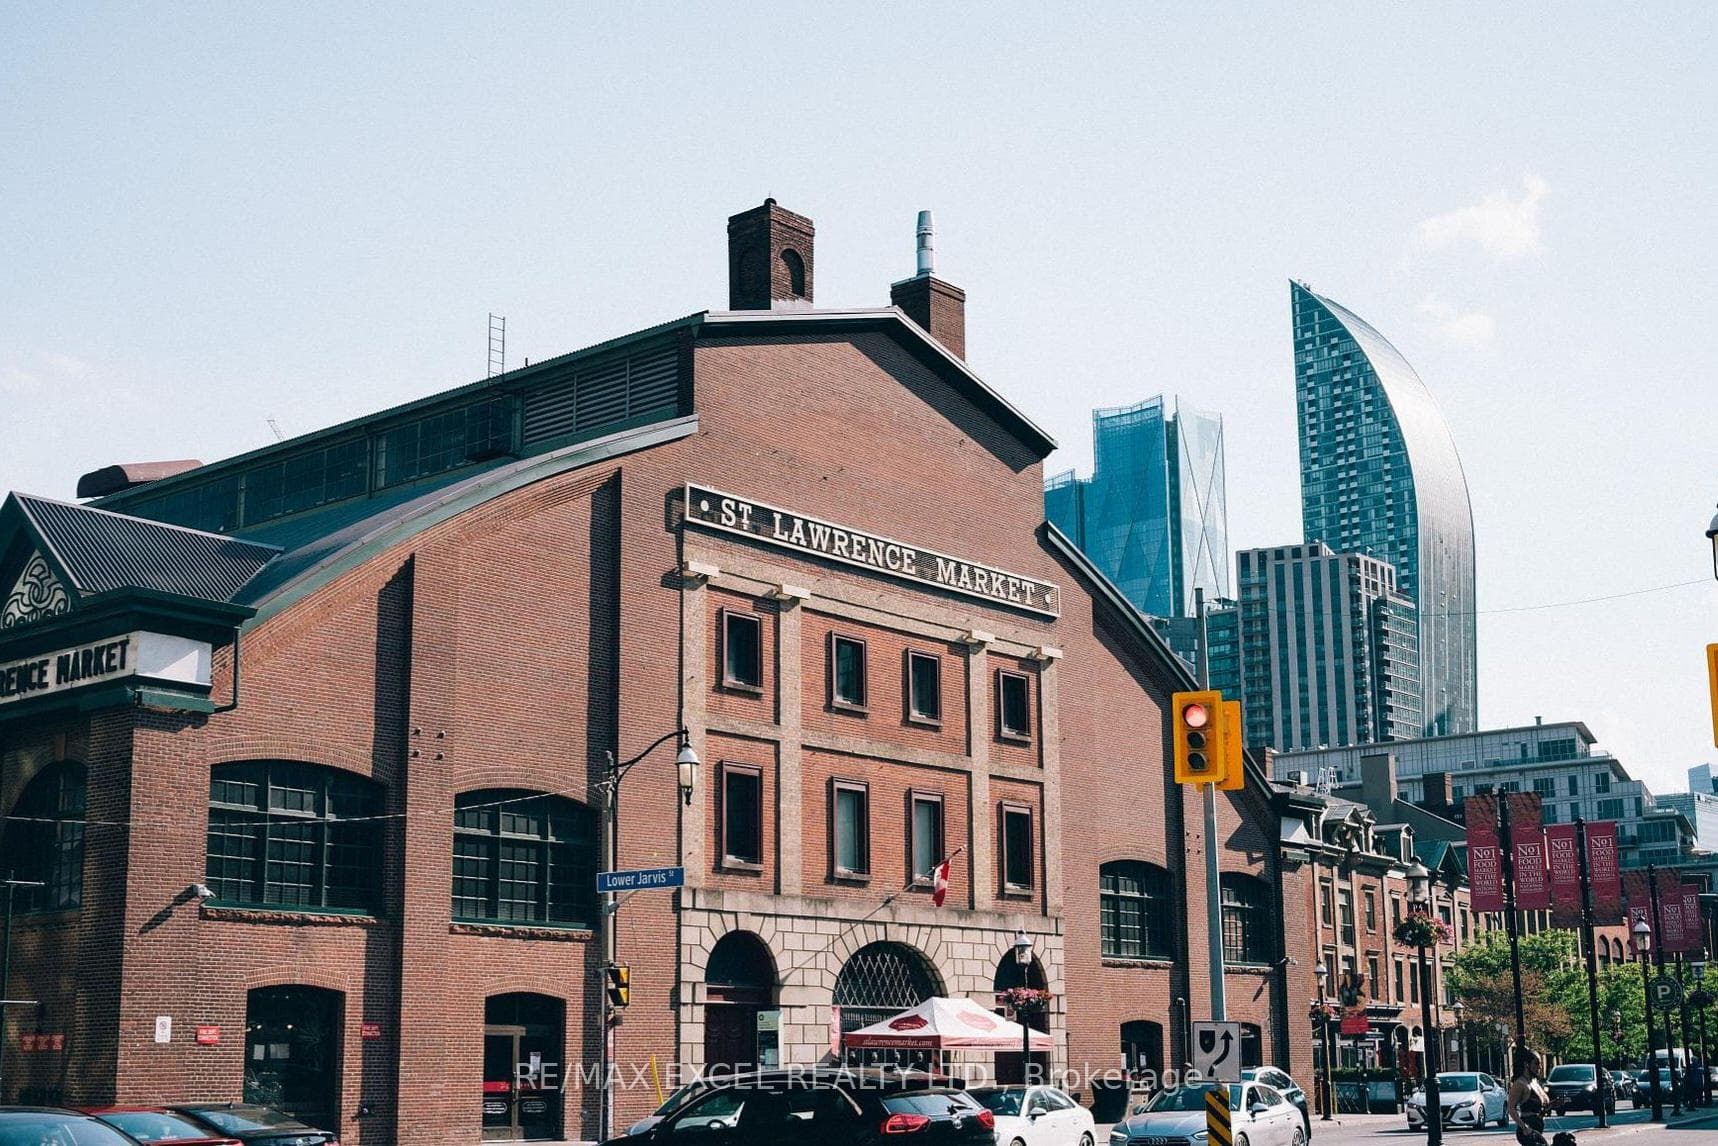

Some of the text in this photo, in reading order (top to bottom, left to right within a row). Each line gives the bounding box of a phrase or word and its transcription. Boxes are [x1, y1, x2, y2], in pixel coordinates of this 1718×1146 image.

[772, 512, 916, 576] LAWRENCE
[935, 557, 1036, 607] MARKET
[56, 639, 130, 684] MARKET
[1518, 857, 1542, 865] FOOD
[606, 874, 635, 887] Lower
[637, 870, 667, 885] Jarvis
[1656, 984, 1671, 1000] P
